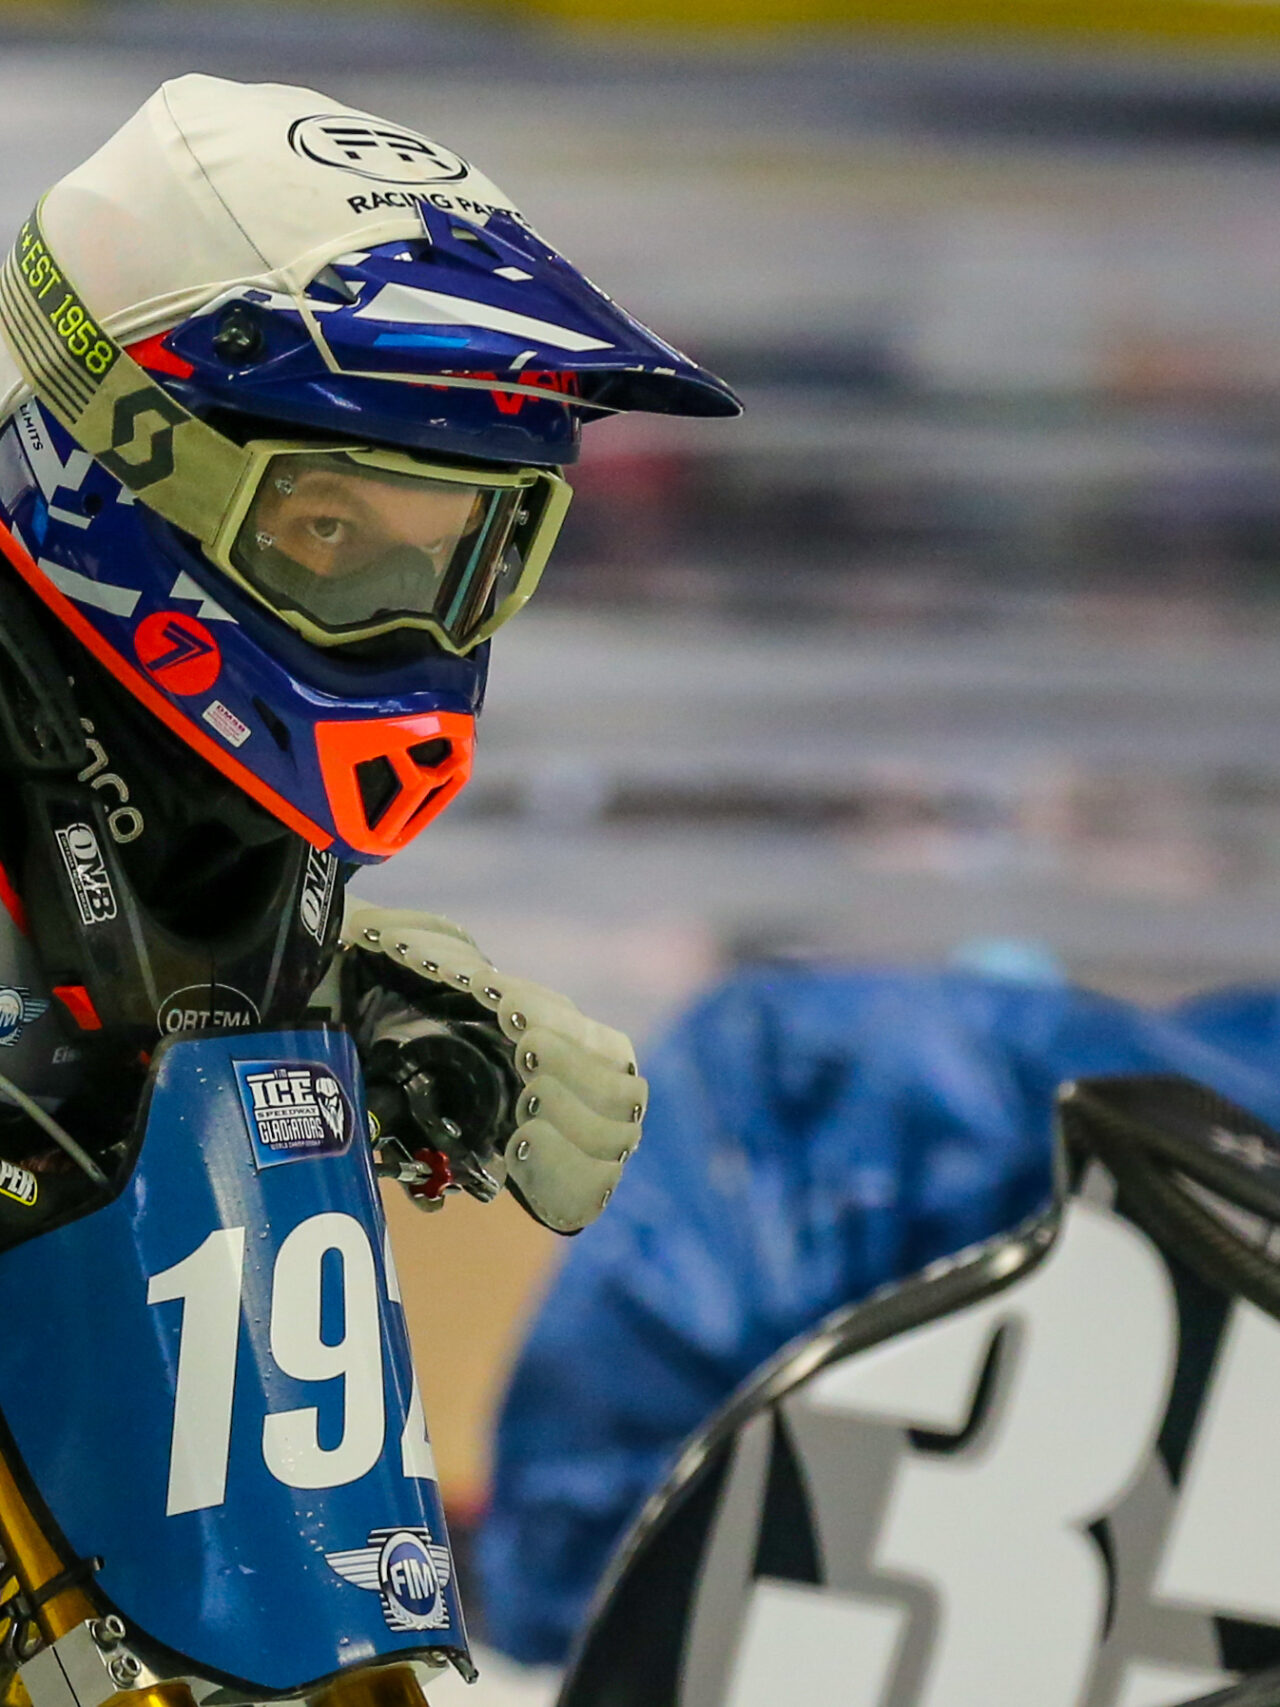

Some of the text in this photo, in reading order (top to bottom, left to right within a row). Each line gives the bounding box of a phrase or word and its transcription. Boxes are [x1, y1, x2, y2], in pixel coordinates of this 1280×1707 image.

[347, 191, 453, 216] RACING
[21, 240, 113, 375] EST 1958
[248, 1078, 318, 1110] ICE
[256, 1106, 317, 1118] SPEEDWAY
[389, 1558, 436, 1600] FIM
